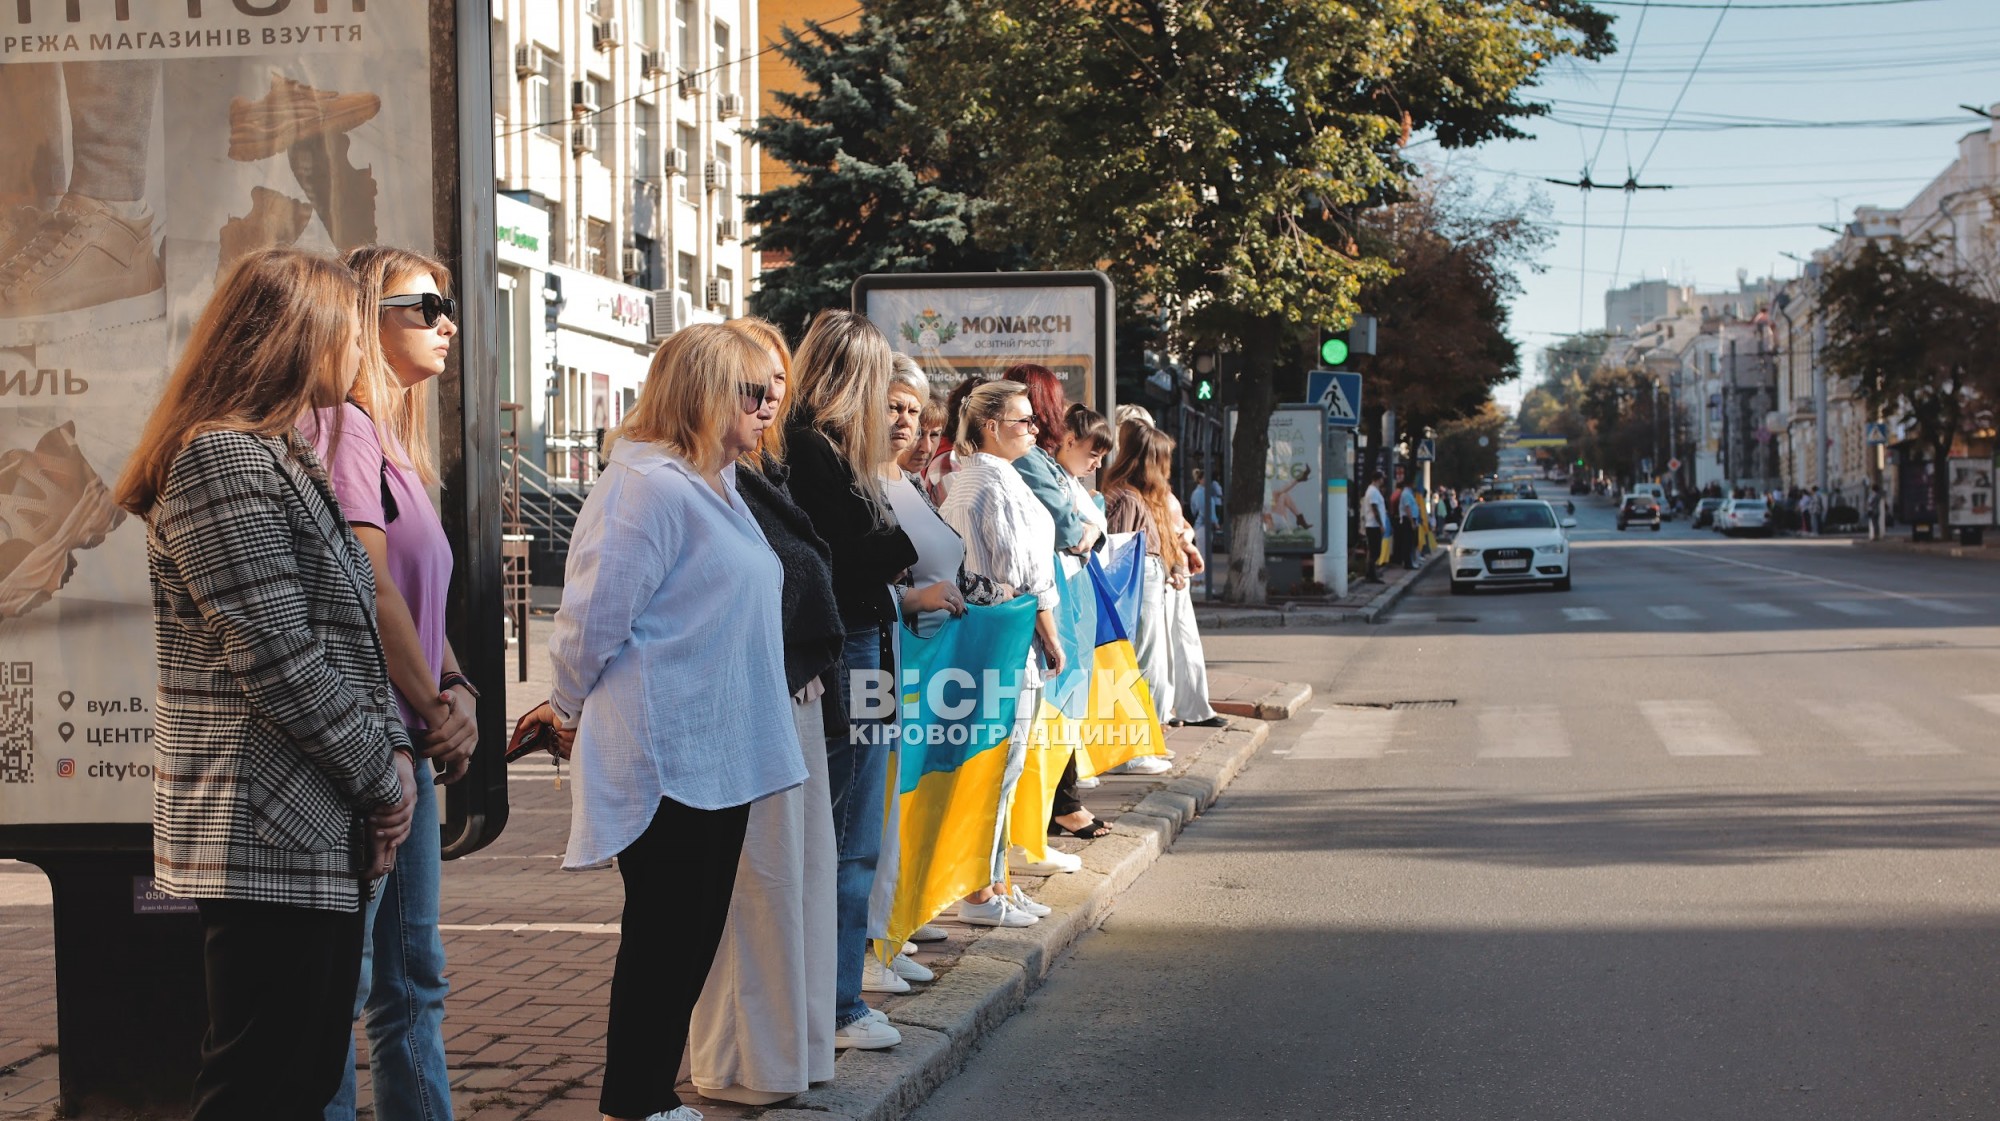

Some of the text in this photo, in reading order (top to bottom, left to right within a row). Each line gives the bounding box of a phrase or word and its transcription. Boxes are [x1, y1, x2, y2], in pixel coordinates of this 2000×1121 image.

[4, 24, 362, 53] РЕЖА МАГАЗИНІВ ВЗУТТЯ
[962, 314, 1072, 335] MONARCH
[975, 338, 1055, 349] ОСВІТНІЙ ПРОСТІР
[0, 368, 89, 396] ИЛЬ
[927, 371, 968, 382] ЛІЙСЬКА
[87, 728, 155, 747] ЦЕНТР
[145, 891, 166, 900] 050
